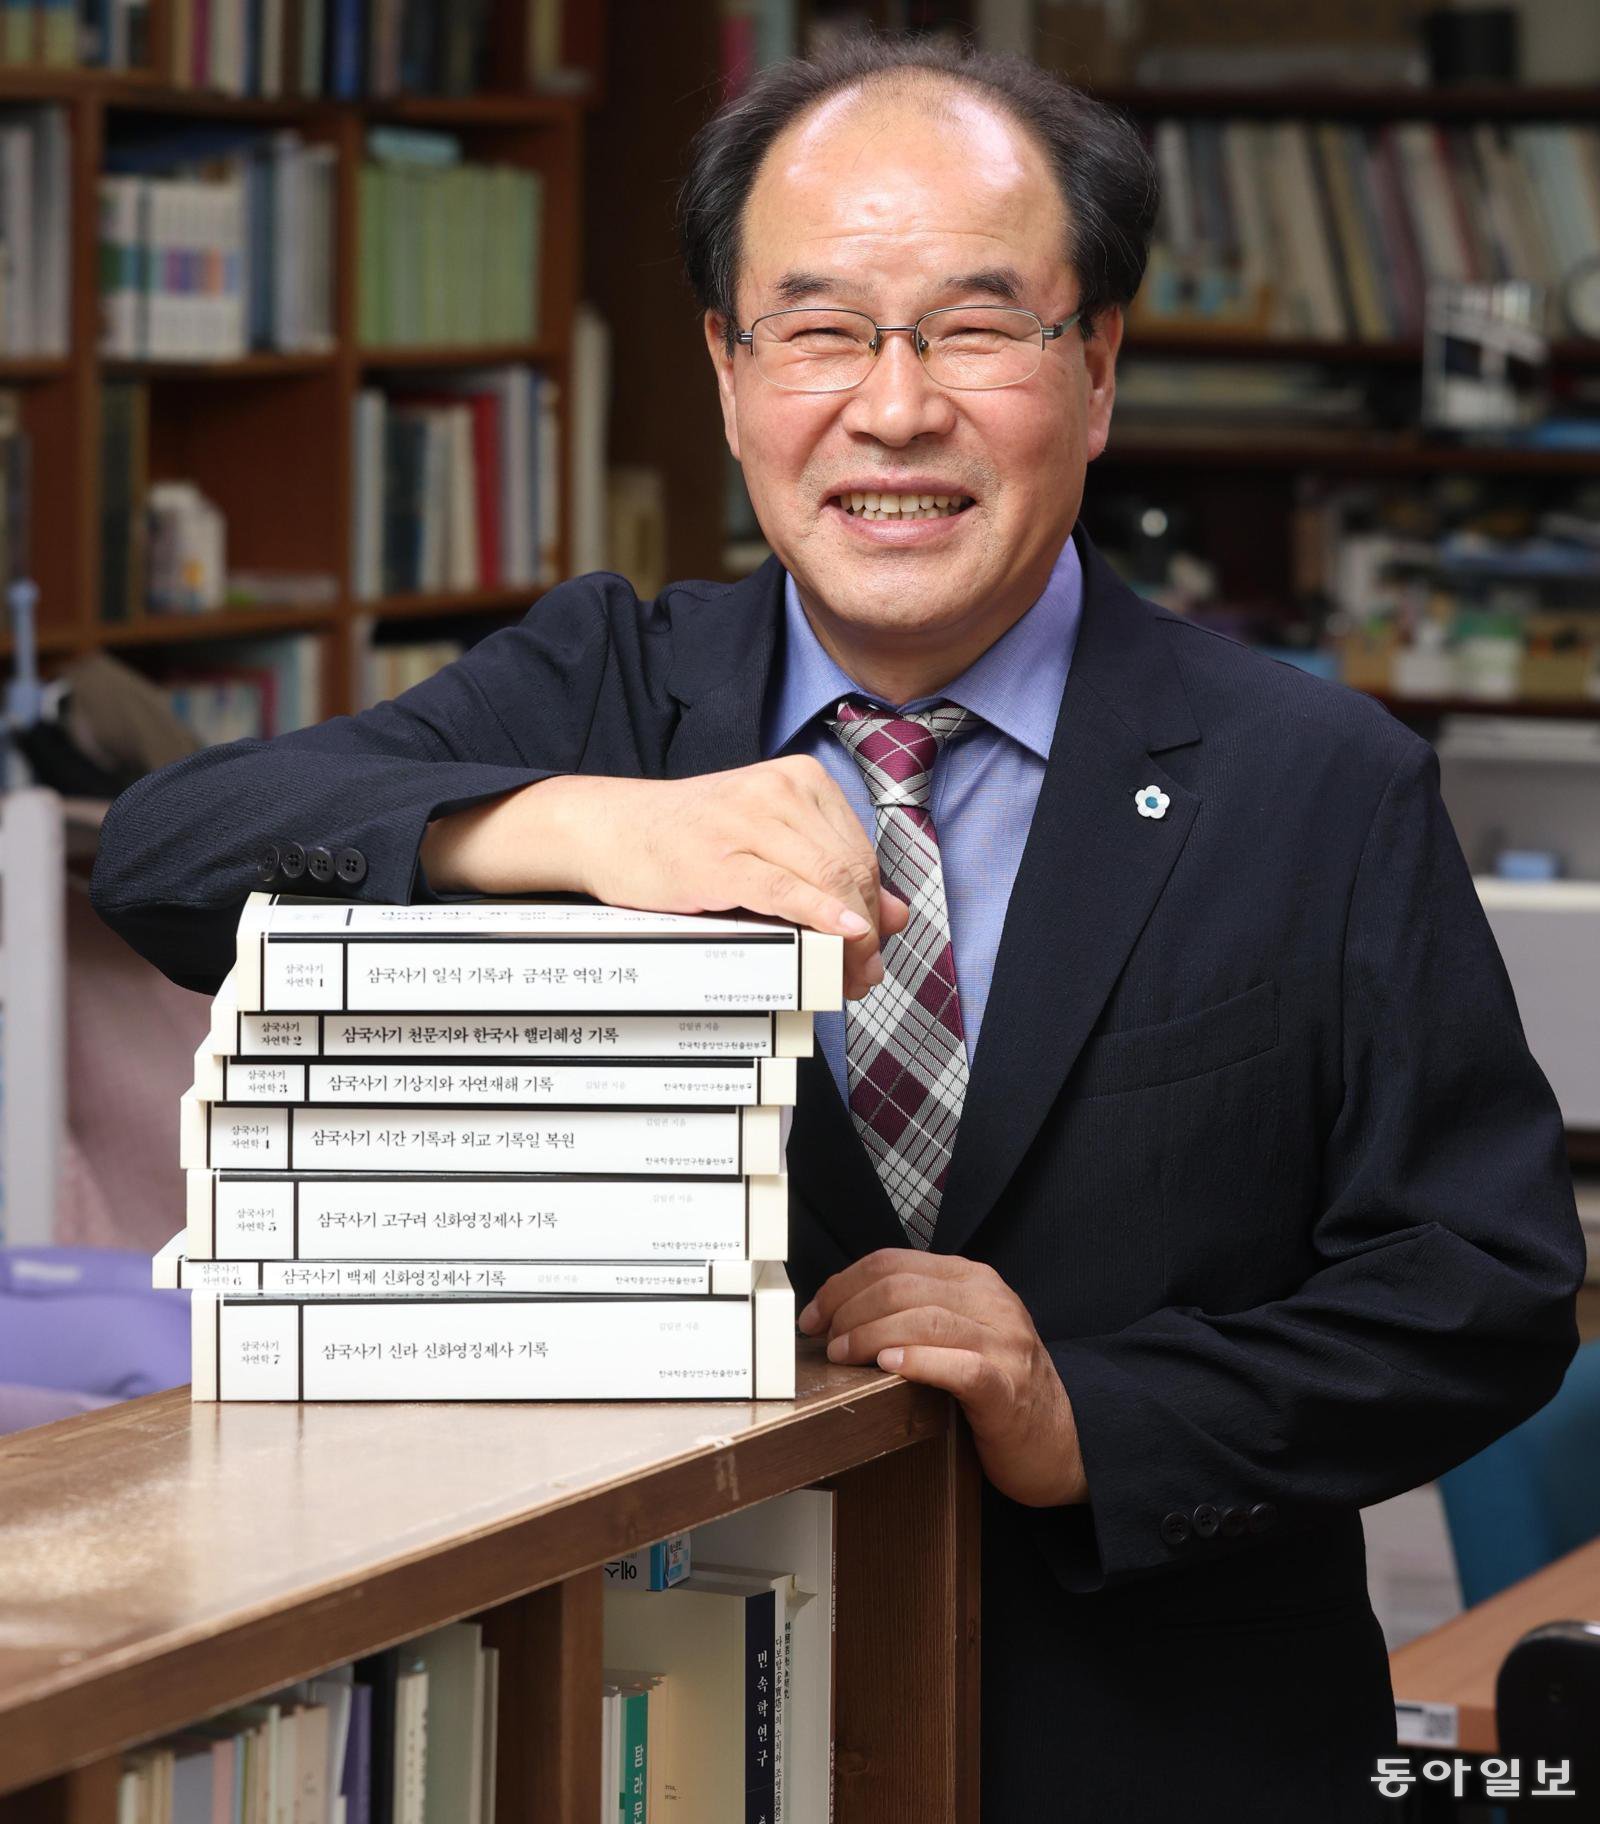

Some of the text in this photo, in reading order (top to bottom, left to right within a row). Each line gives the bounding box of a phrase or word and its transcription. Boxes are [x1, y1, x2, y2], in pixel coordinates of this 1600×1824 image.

[285, 963, 323, 974] 삼국사기
[368, 967, 638, 984] 삼국사기 일식 기록과 금석문 역일 기록
[261, 1021, 300, 1033] 삼국사기
[342, 1026, 620, 1044] 삼국사기 천문지와 한국사 핼리혜성 기록
[248, 1069, 286, 1080] 삼국사기
[328, 1075, 387, 1091] 삼국사기
[394, 1075, 454, 1092] 기상지와
[459, 1076, 518, 1092] 자연재해
[525, 1076, 554, 1092] 기록
[230, 1125, 270, 1136] 삼국사기
[312, 1129, 574, 1149] 삼국사기 시간 기록과 외교 기록일 복원
[237, 1208, 274, 1219] 삼국사기
[318, 1212, 558, 1229] 삼국사기 고구려 신화영징제사 기록
[201, 1263, 239, 1275] 삼국사기
[282, 1268, 340, 1285] 삼국사기
[348, 1269, 375, 1285] 백제
[383, 1269, 471, 1286] 신화영징제사
[477, 1271, 506, 1287] 기록
[240, 1340, 279, 1352] 삼국사기
[322, 1342, 548, 1360] 삼국사기 신라 신화영징제사 기록
